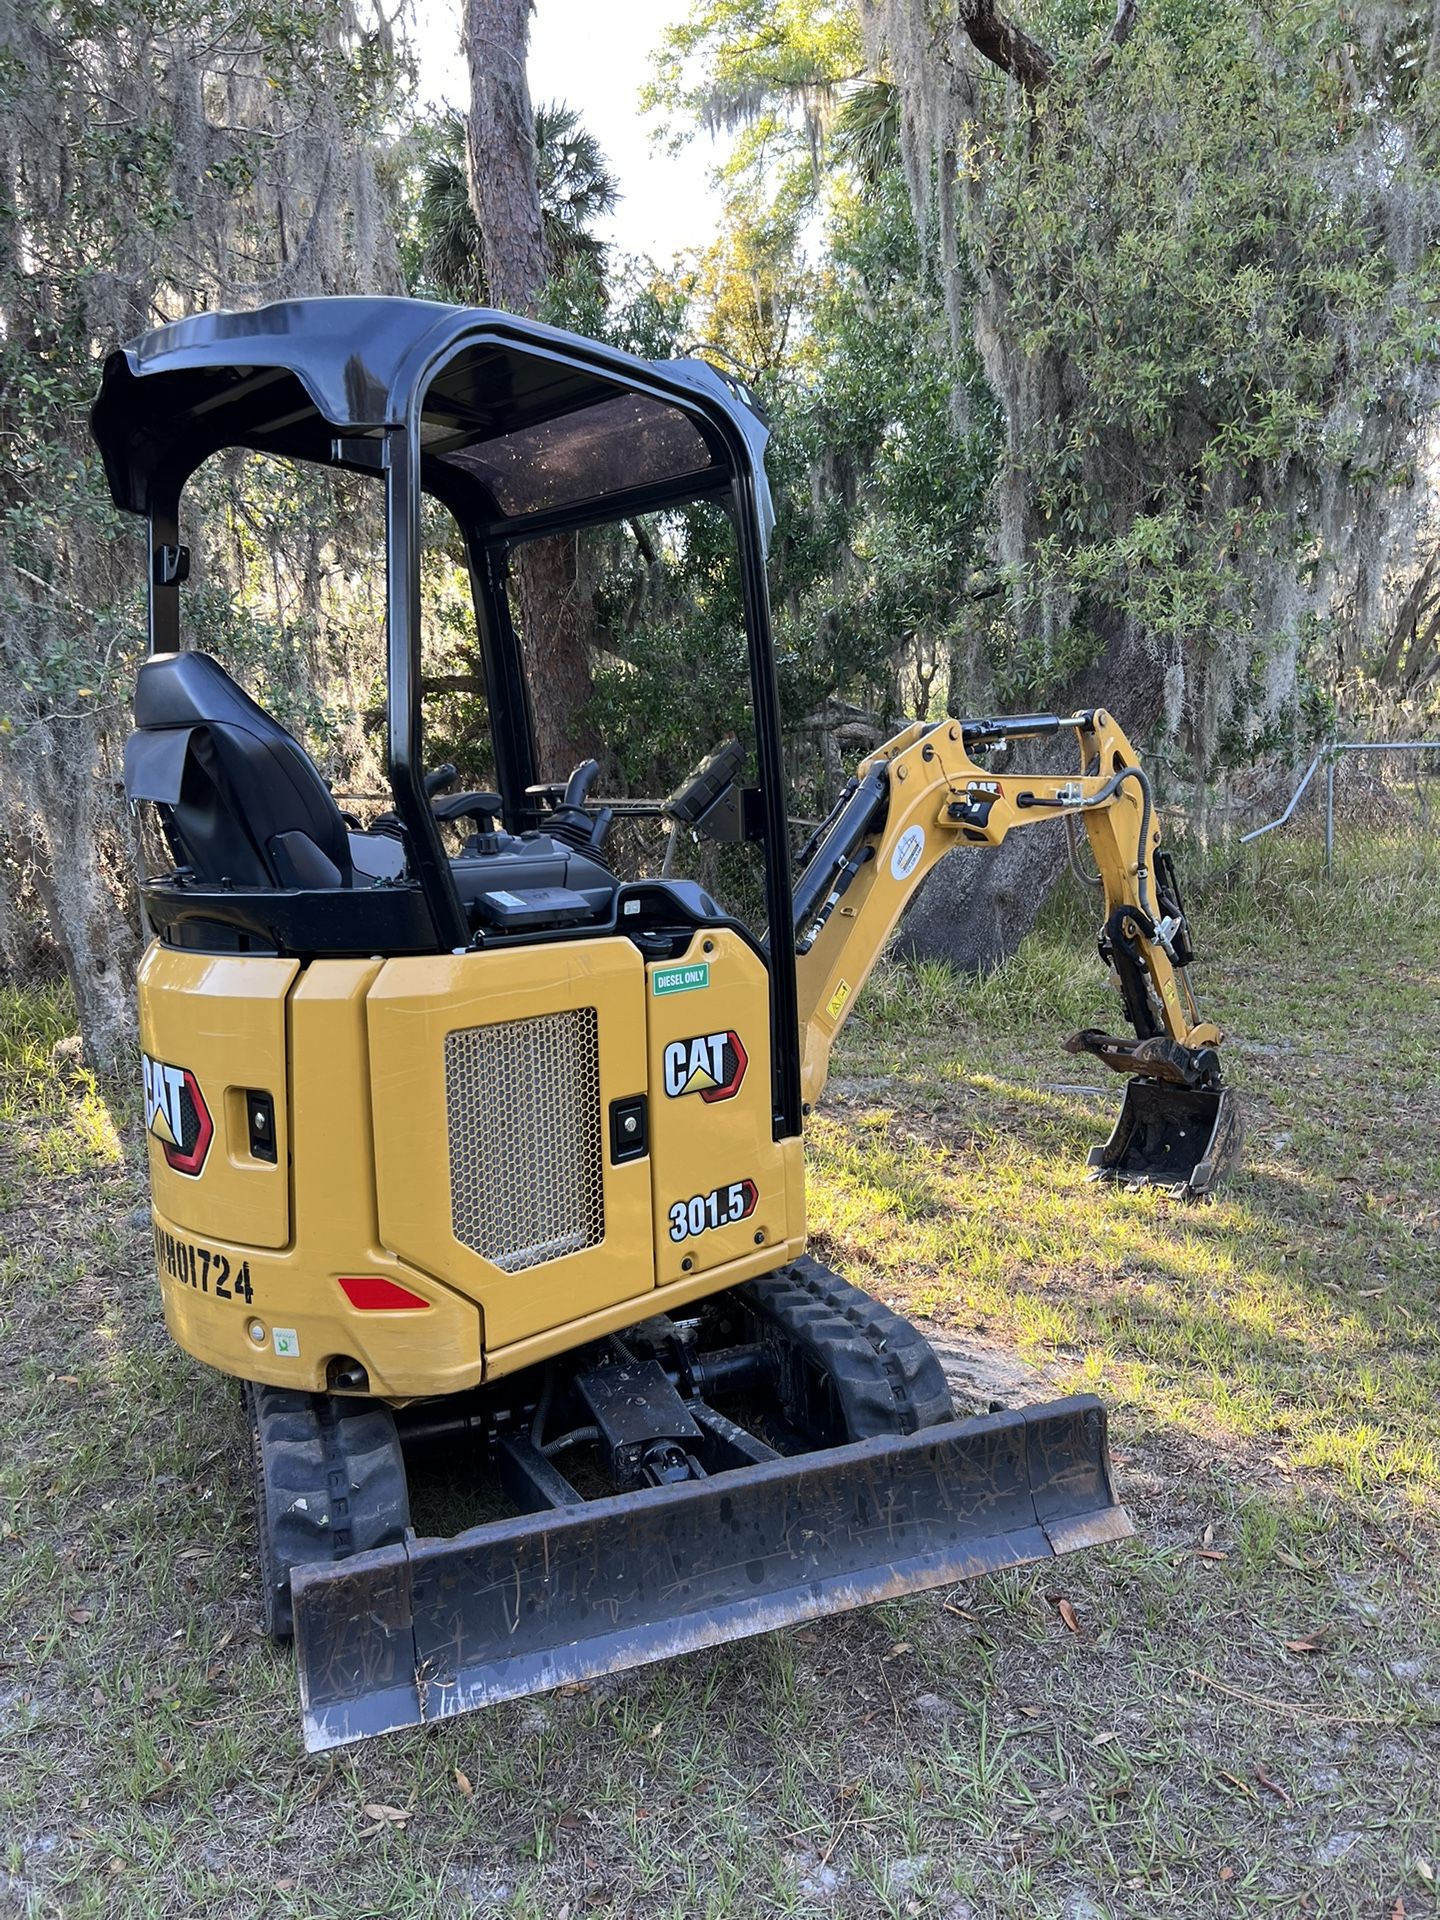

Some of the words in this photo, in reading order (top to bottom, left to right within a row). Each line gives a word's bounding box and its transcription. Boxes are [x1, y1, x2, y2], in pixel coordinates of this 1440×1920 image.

[657, 973, 684, 988] DIESEL
[684, 970, 704, 984] ONLY
[664, 1032, 728, 1097] CAT
[142, 1053, 185, 1147] CAT
[670, 1182, 744, 1241] 301.5
